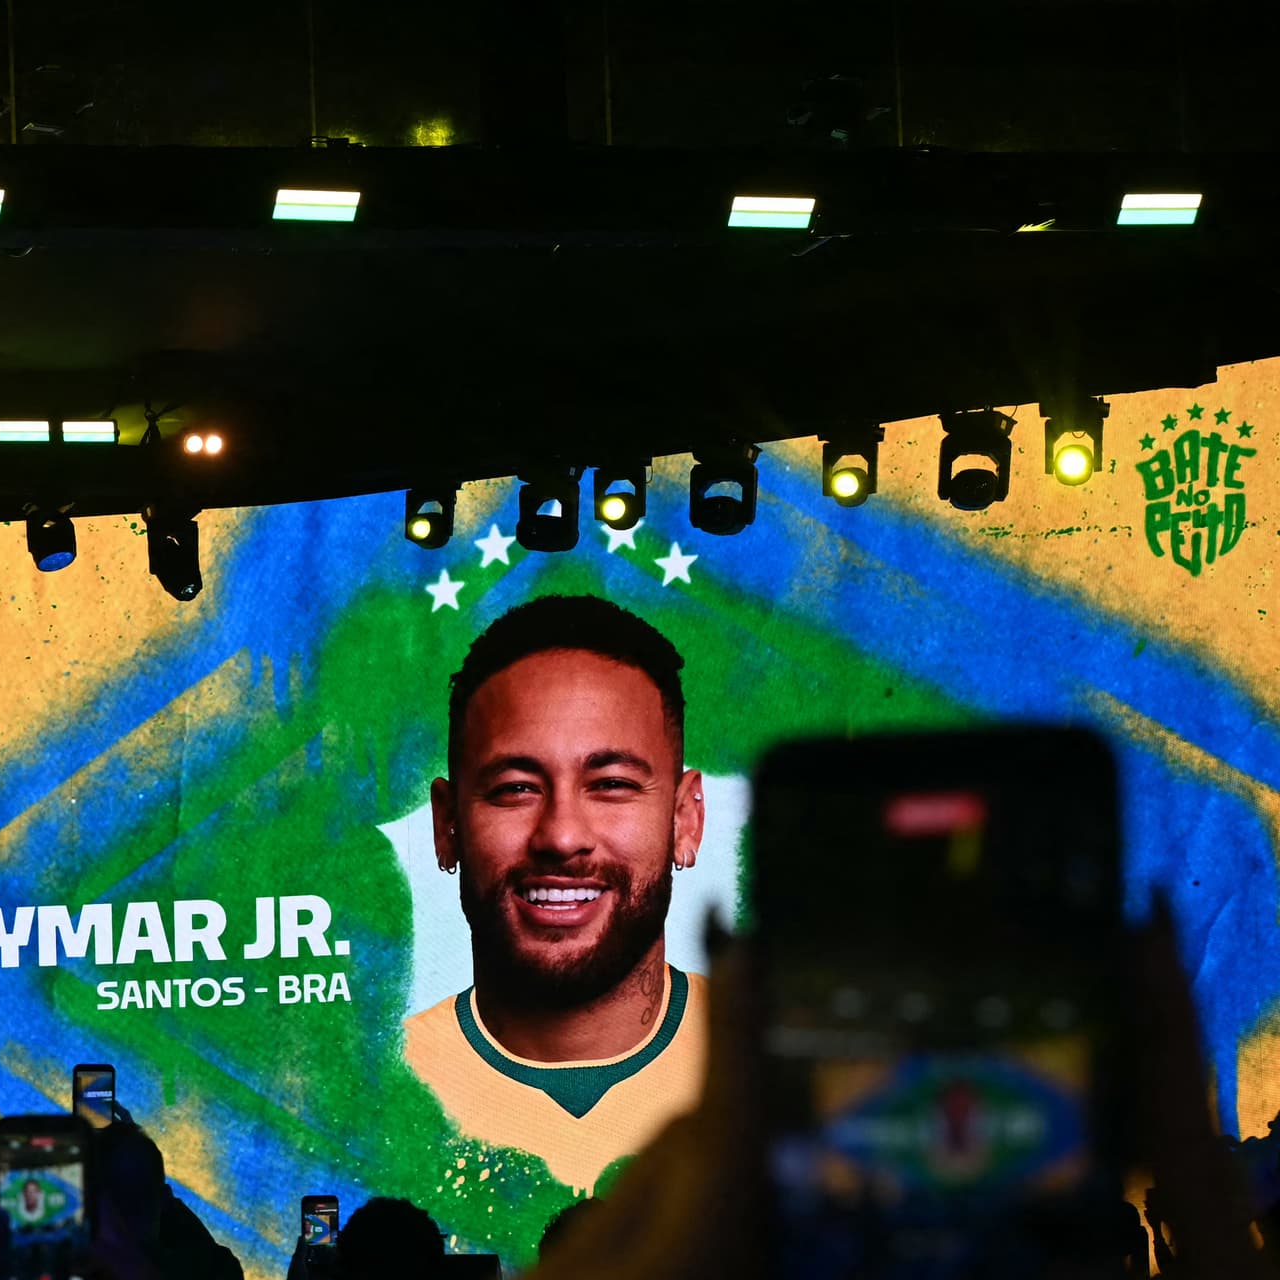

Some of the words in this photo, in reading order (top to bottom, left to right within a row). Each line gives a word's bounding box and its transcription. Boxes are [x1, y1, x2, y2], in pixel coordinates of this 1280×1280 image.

[1136, 430, 1257, 500] BATE
[1176, 483, 1210, 506] NO
[1145, 493, 1246, 577] PEITO
[243, 894, 351, 960] JR.
[96, 975, 246, 1011] SANTOS
[278, 972, 352, 1005] BRA
